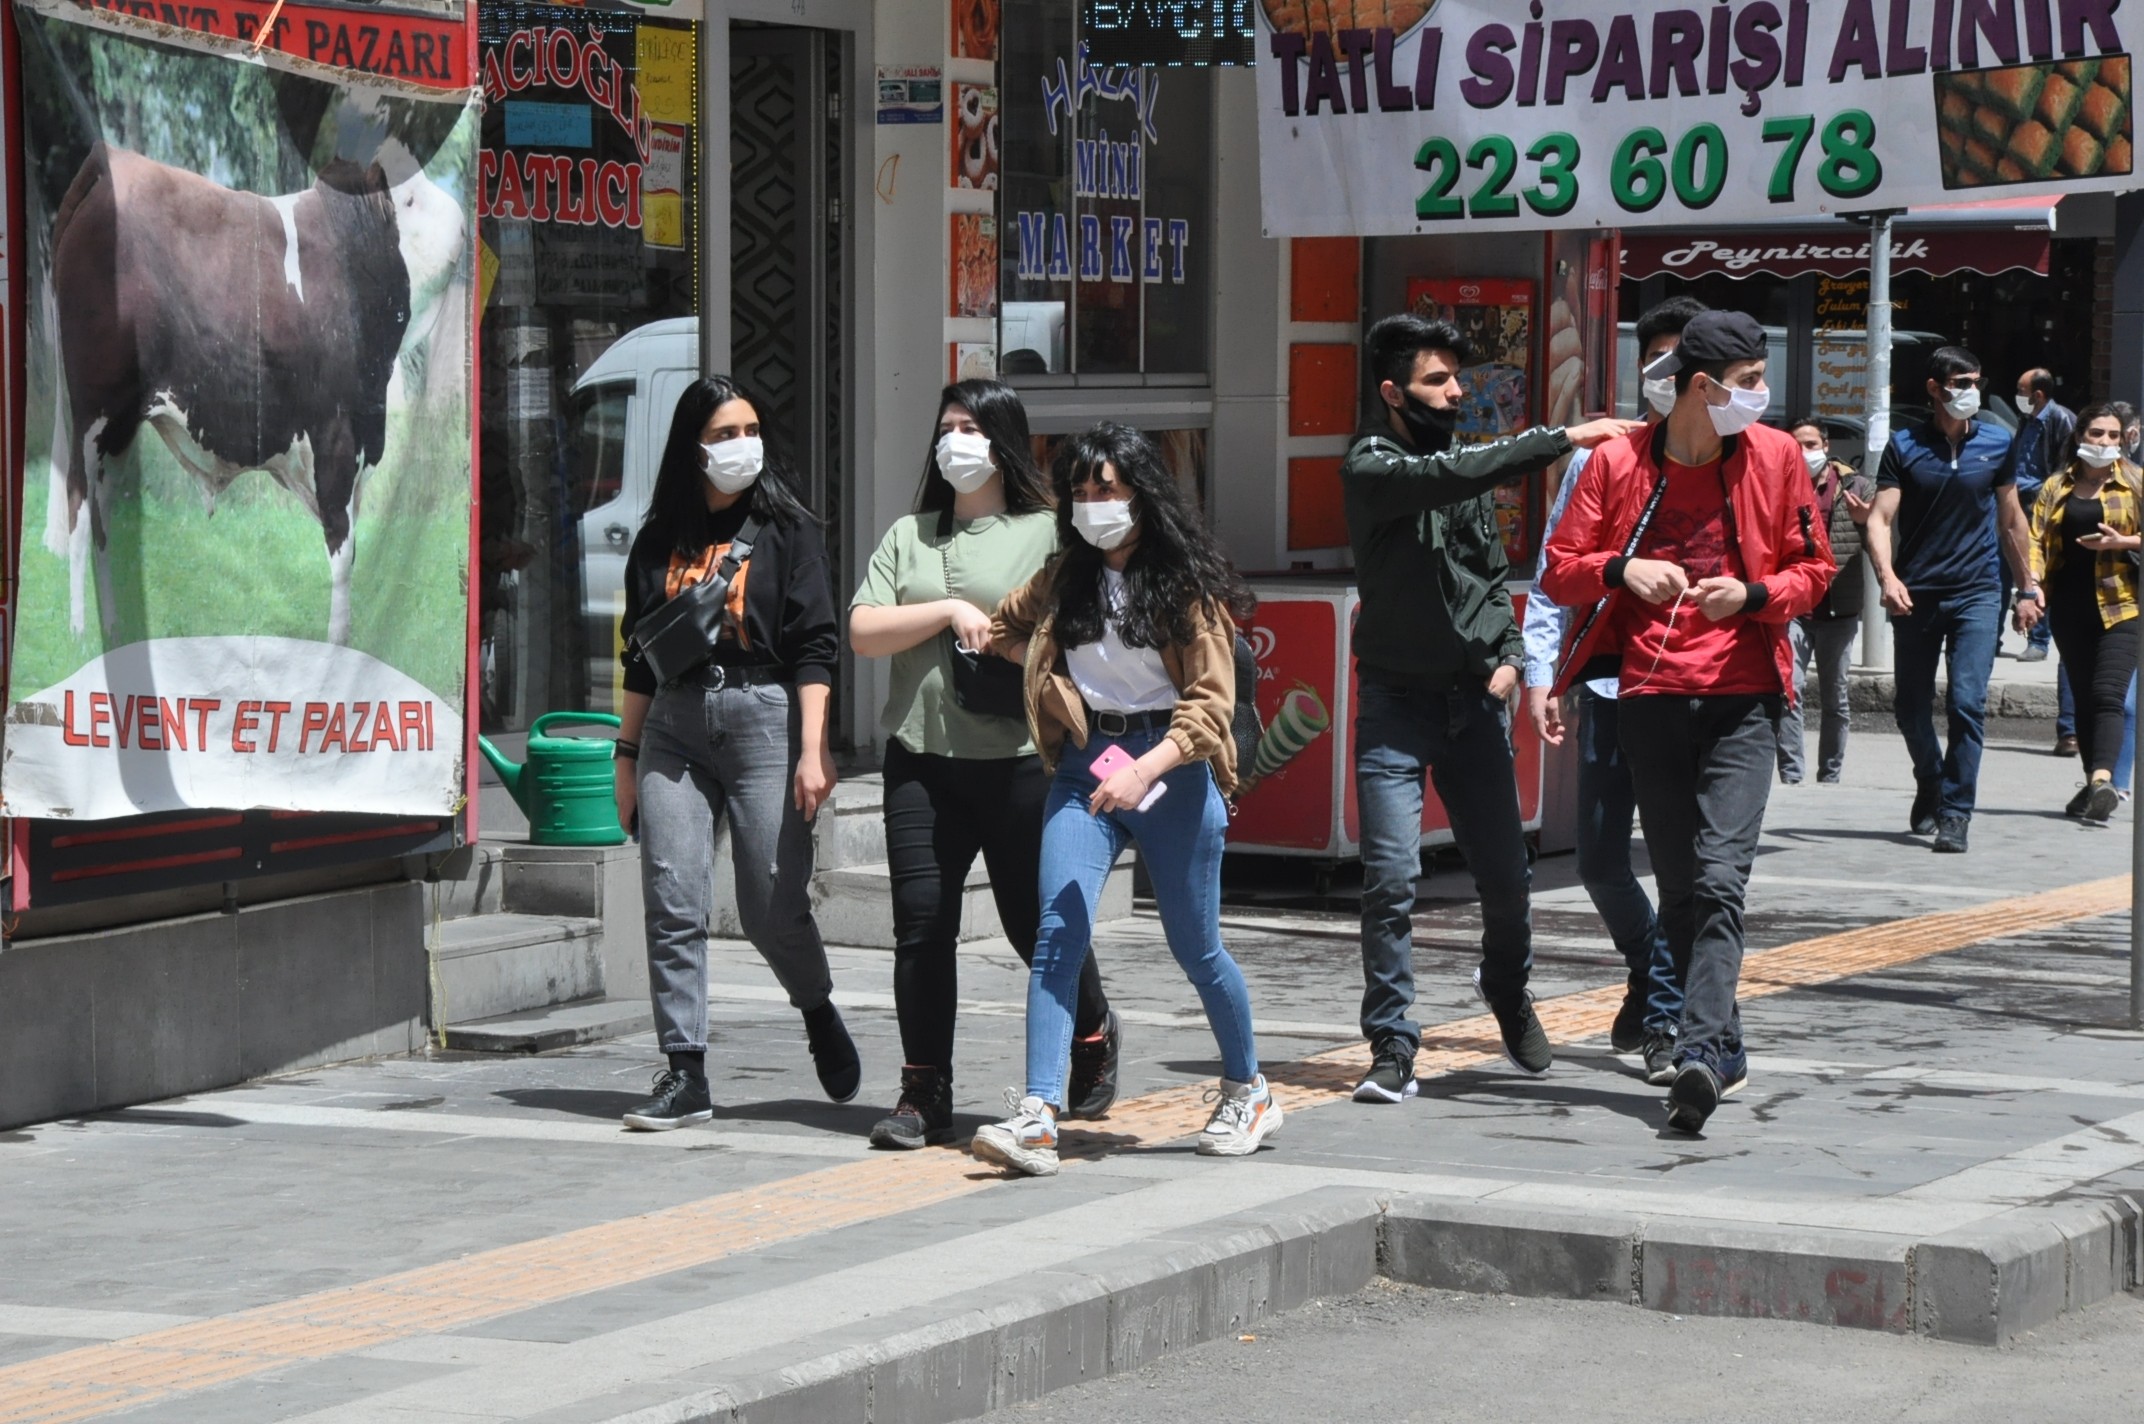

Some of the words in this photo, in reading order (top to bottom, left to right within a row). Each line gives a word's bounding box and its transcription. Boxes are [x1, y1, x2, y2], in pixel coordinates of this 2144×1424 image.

[305, 19, 452, 80] PAZARI
[1271, 27, 1443, 116] TATLI
[1828, 0, 2124, 83] ALINIR
[479, 148, 642, 229] TATLICI
[1076, 128, 1141, 200] MİNİ
[1414, 132, 1580, 219] 223
[1610, 121, 1729, 213] 60
[1761, 109, 1883, 198] 78
[1018, 211, 1189, 284] MARKET
[1662, 238, 1929, 270] Peynirciik
[1817, 297, 1861, 315] Tulum
[63, 690, 221, 752] LEVENT
[232, 700, 291, 753] ET
[298, 700, 433, 753] PAZARI
